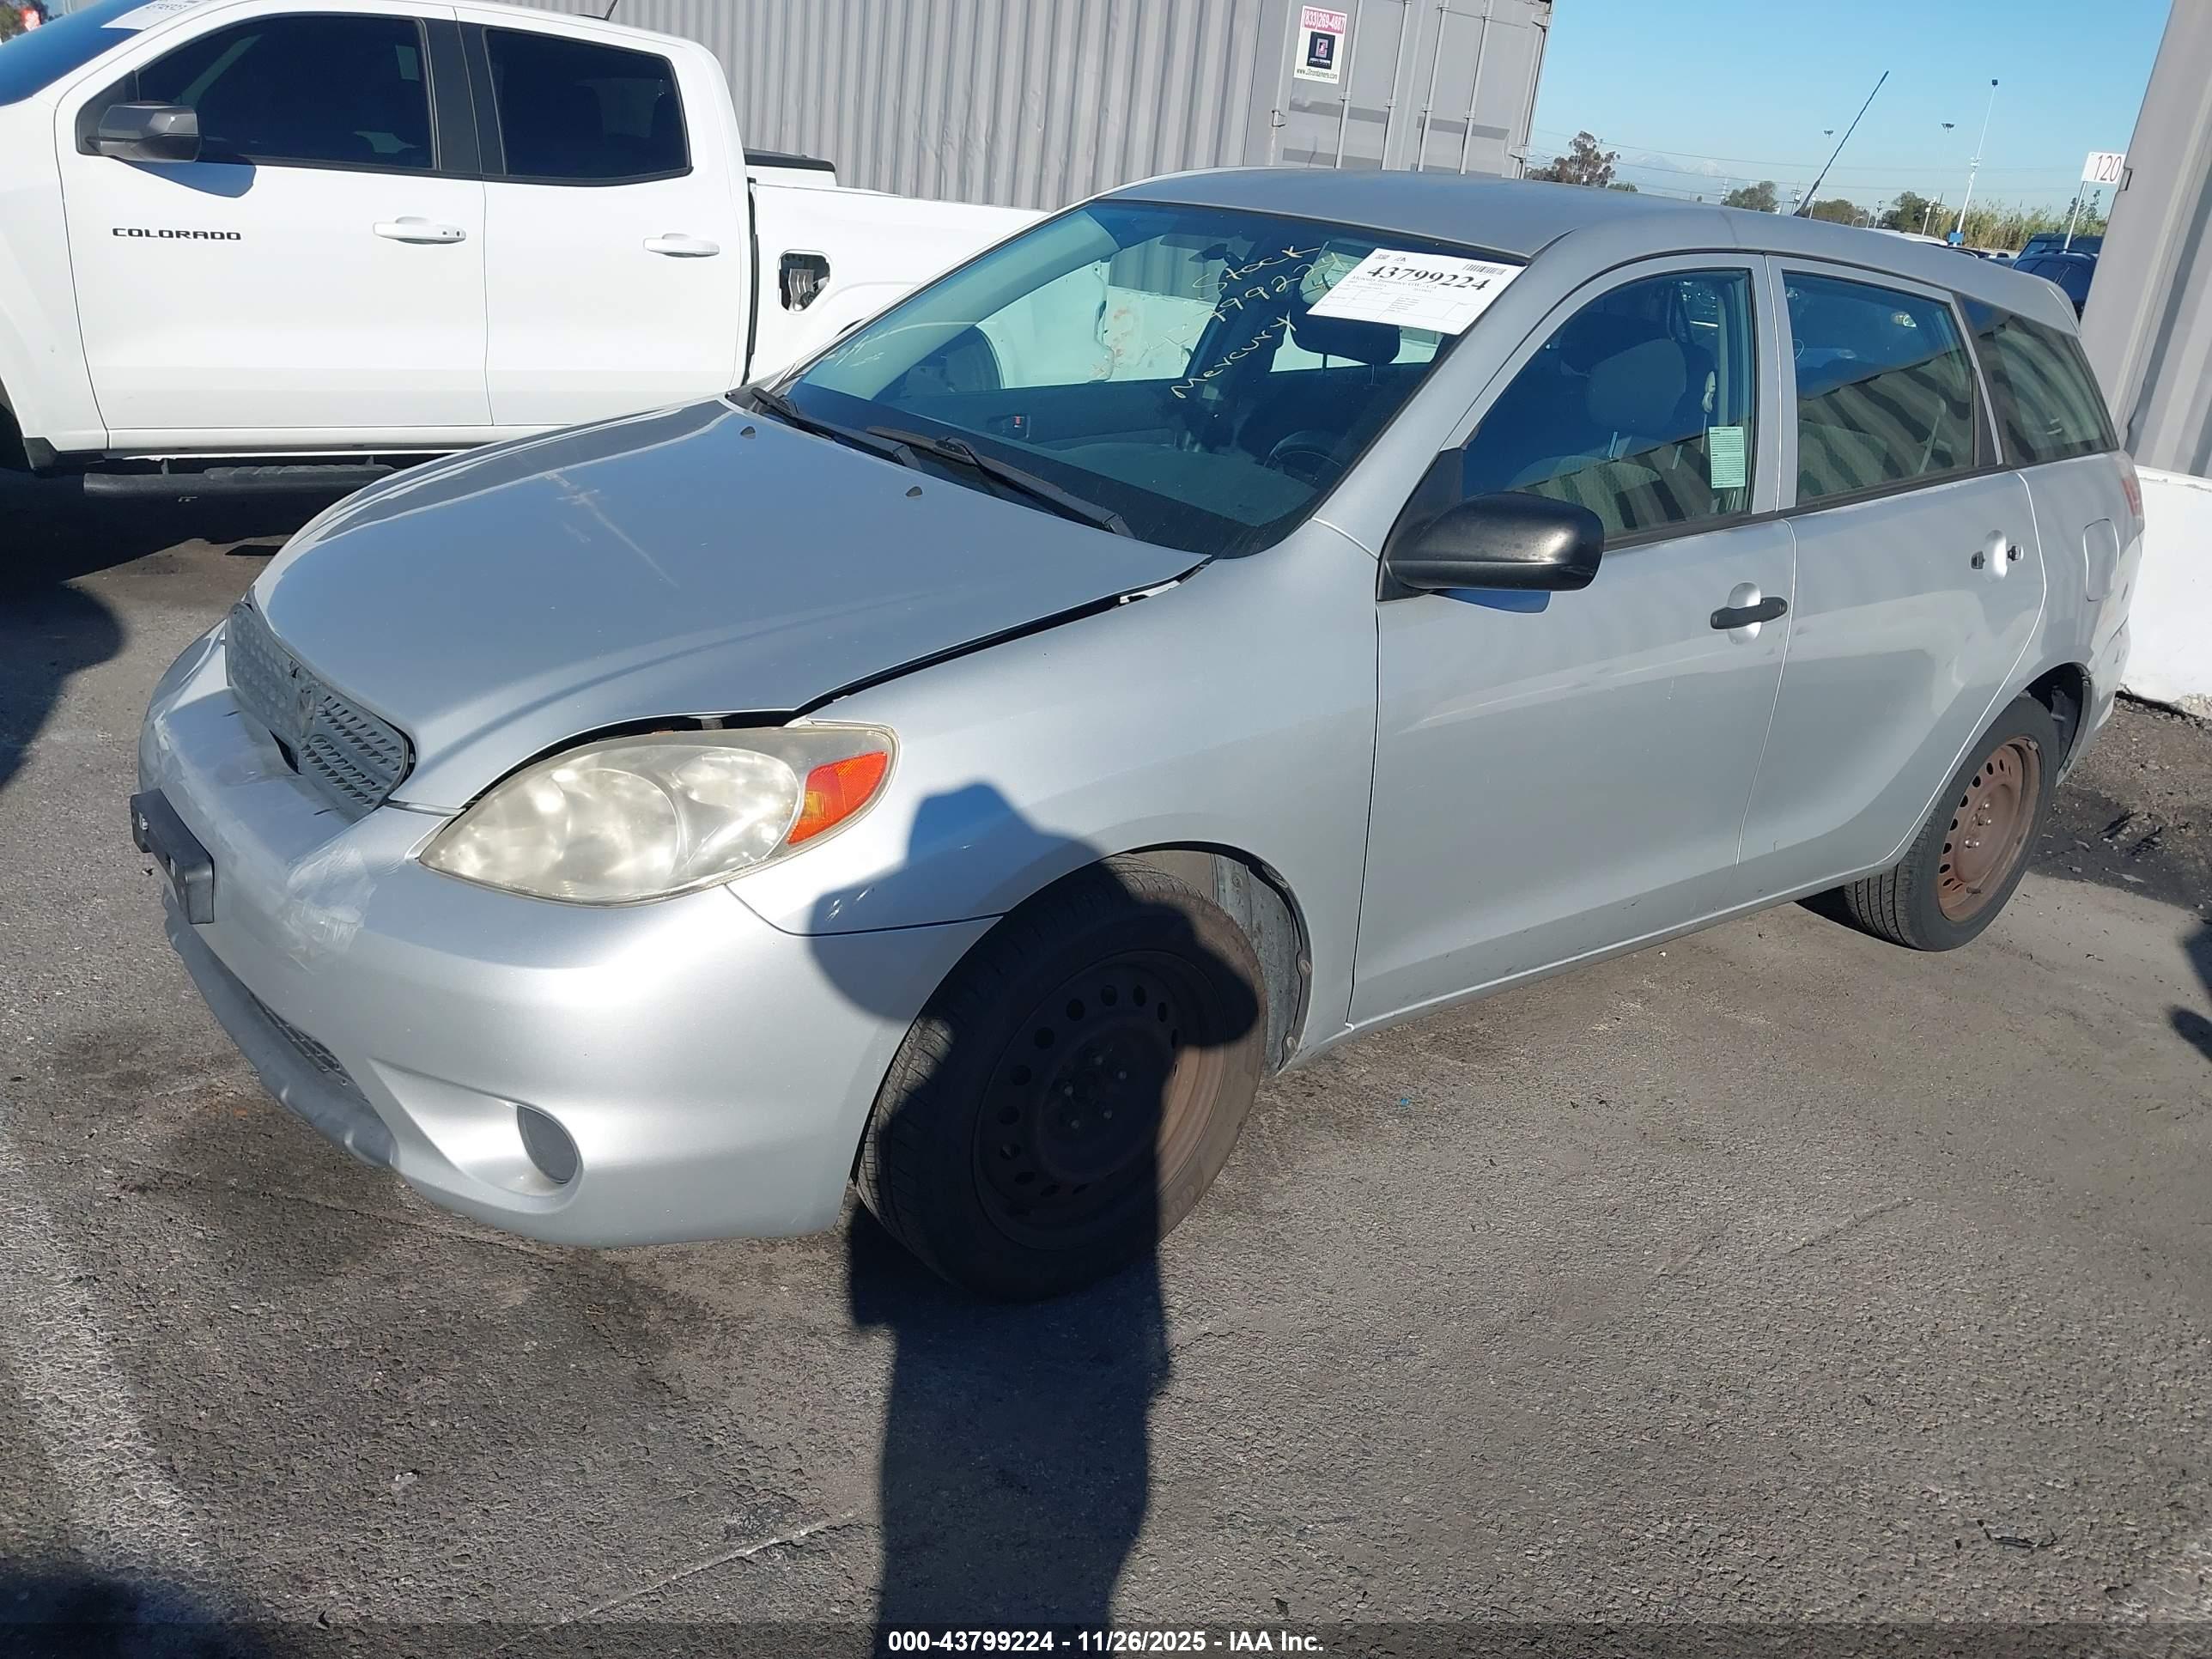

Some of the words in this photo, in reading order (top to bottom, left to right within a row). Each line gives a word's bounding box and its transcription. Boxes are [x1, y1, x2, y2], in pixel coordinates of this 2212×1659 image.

[1304, 9, 1346, 32] (833)269-4887
[2094, 155, 2122, 182] 120
[112, 228, 241, 240] COLORADO
[1193, 246, 1321, 293] Stock
[1367, 264, 1492, 291] 43799224
